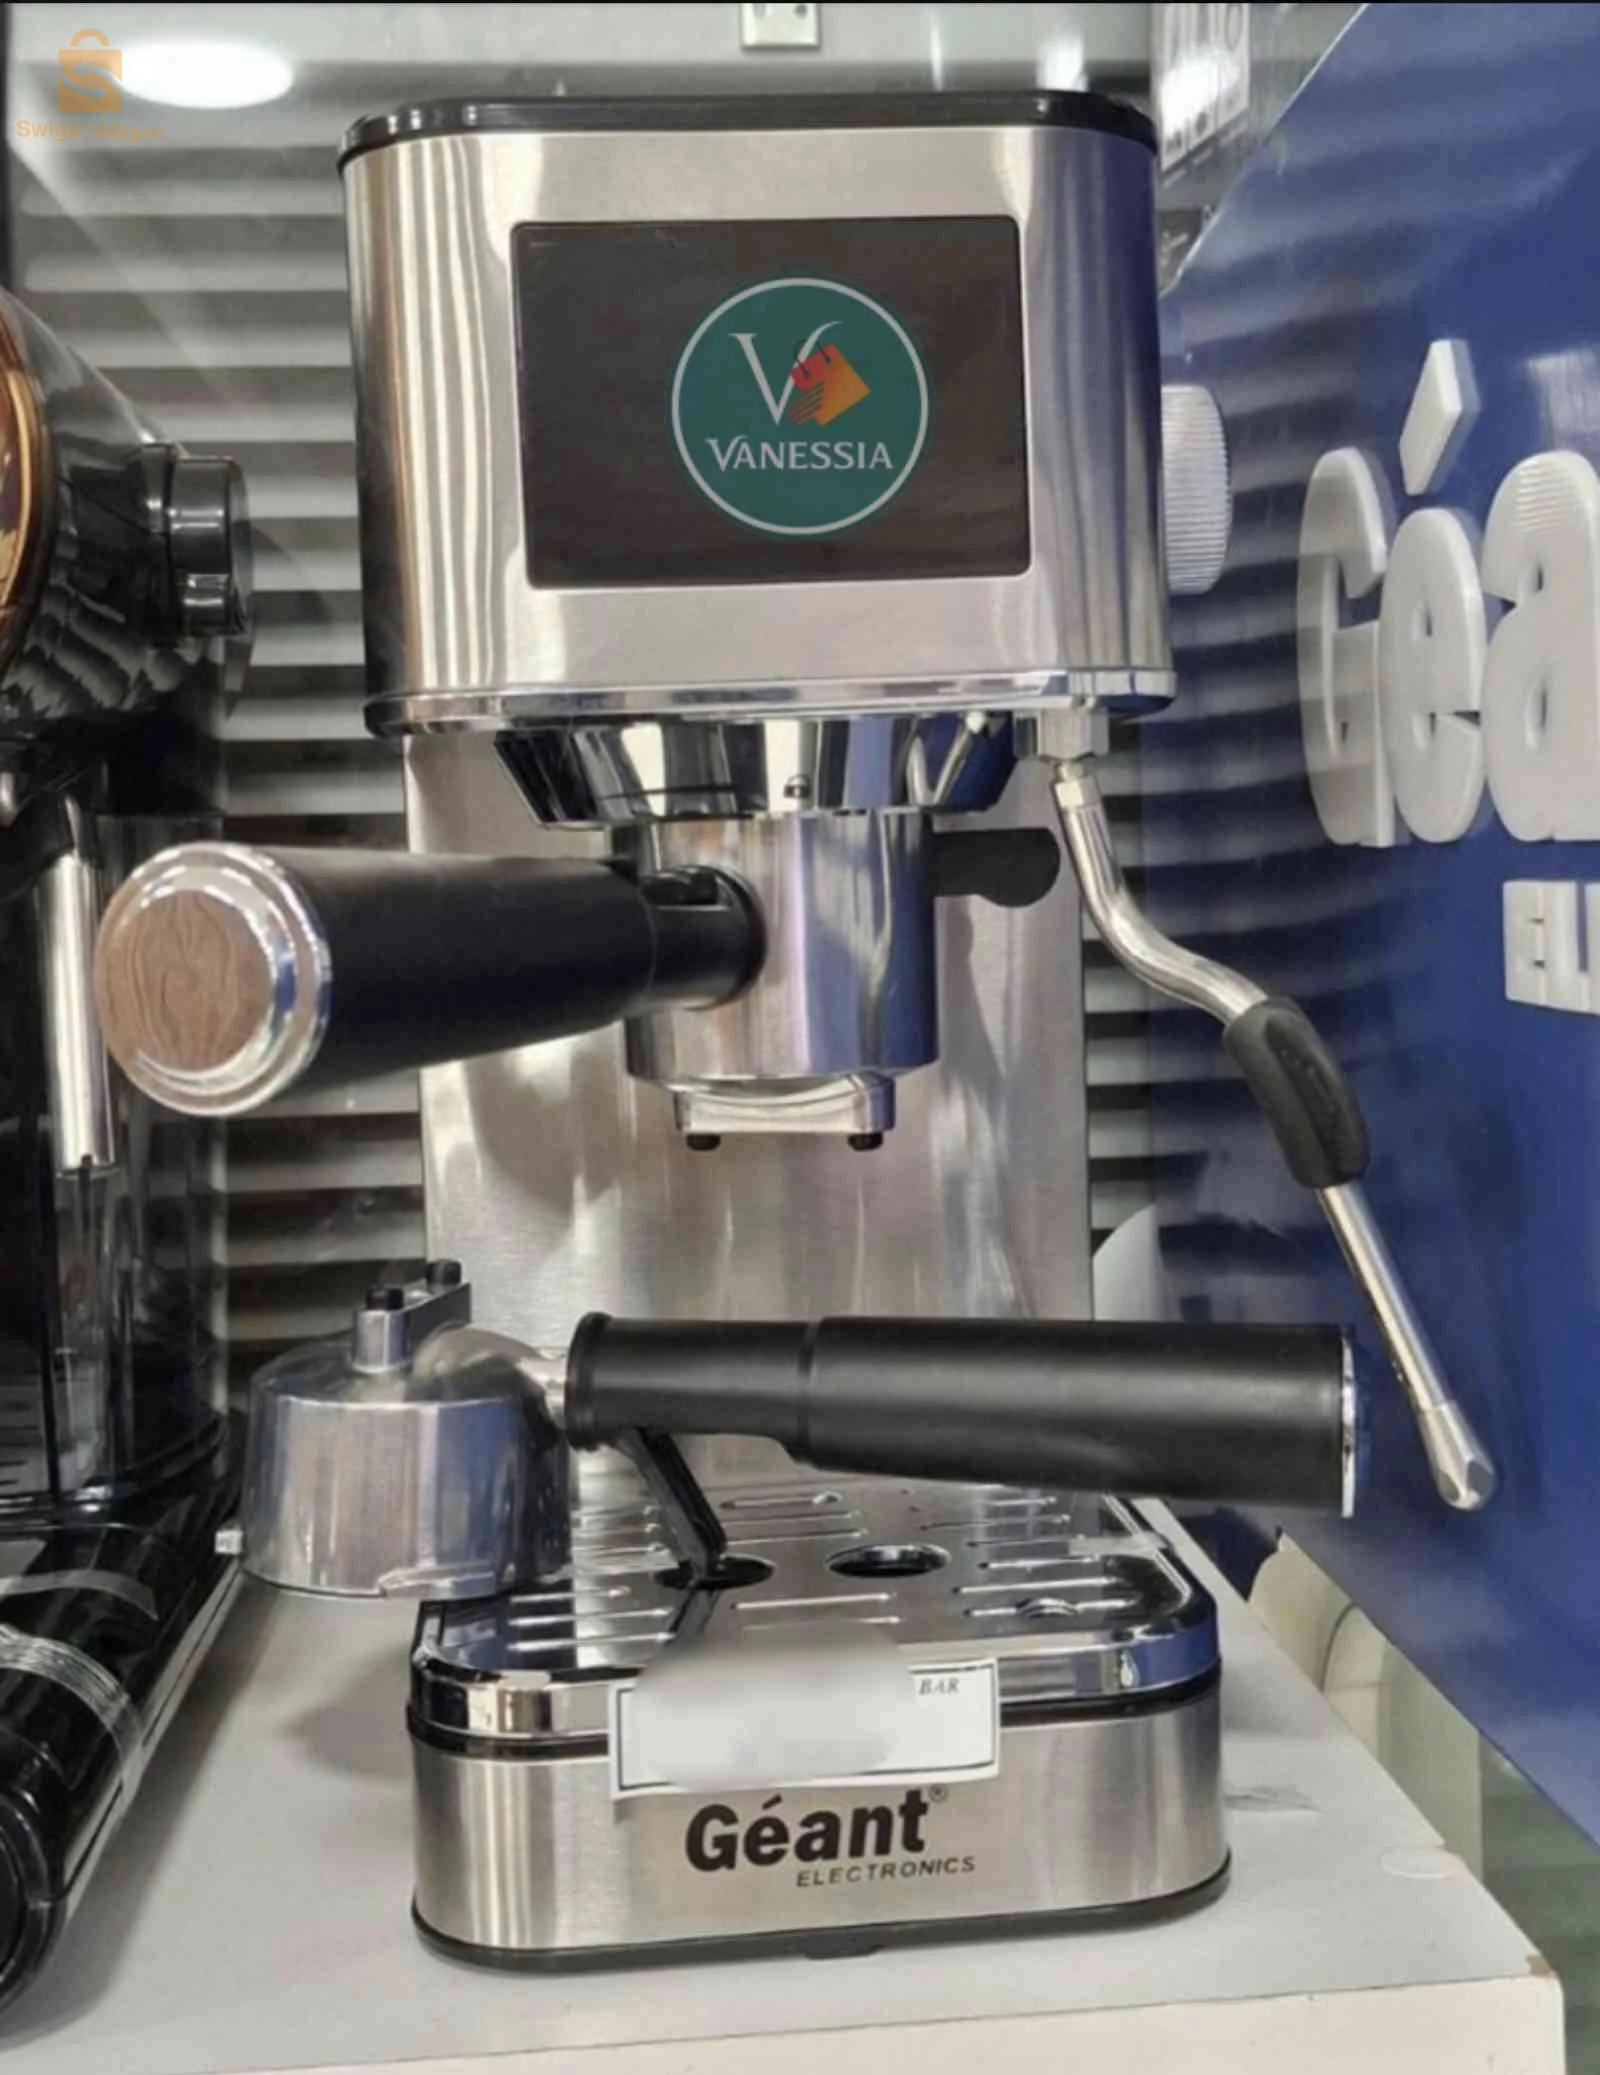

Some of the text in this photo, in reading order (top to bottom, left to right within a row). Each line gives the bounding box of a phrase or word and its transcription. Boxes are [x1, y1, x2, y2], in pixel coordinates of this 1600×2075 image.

[705, 434, 894, 472] VANESSIA
[918, 1677, 960, 1697] BAR
[684, 1788, 929, 1872] Géant
[795, 1855, 976, 1888] ELECTRONICS
